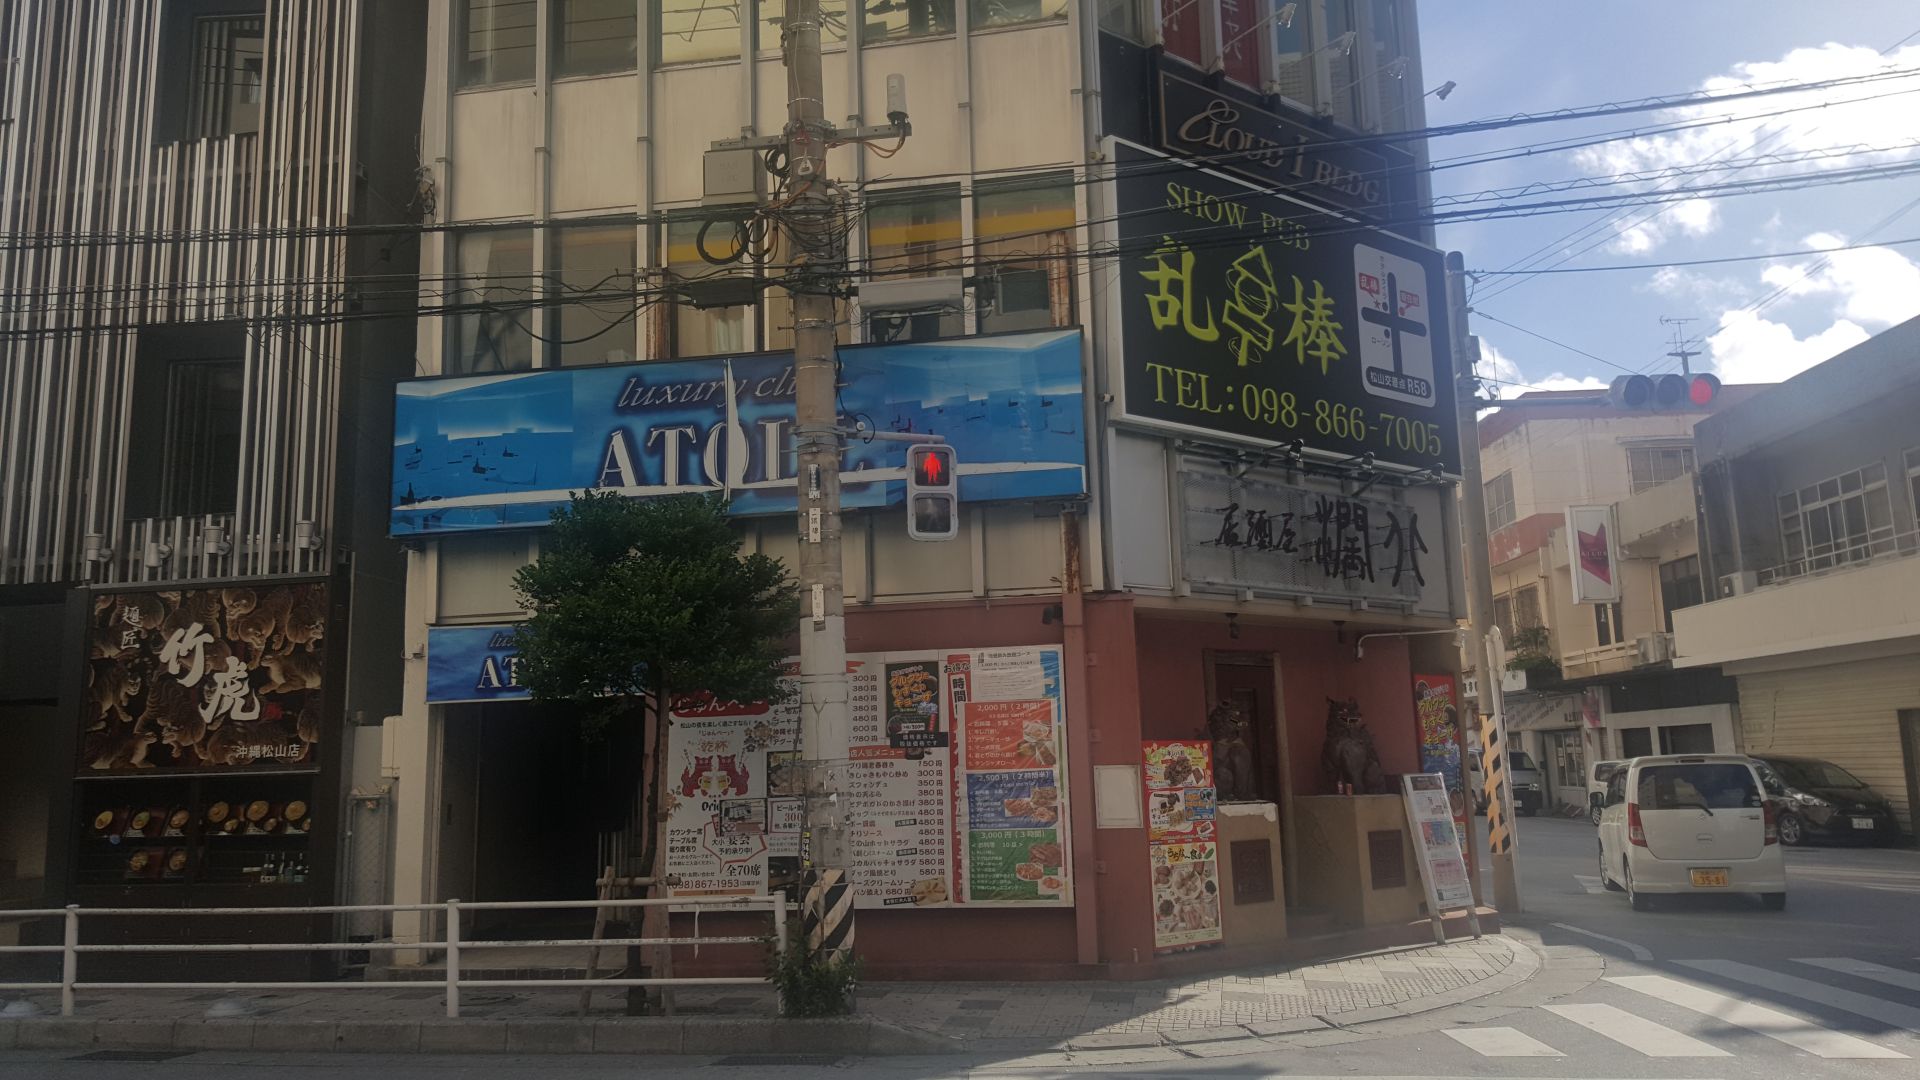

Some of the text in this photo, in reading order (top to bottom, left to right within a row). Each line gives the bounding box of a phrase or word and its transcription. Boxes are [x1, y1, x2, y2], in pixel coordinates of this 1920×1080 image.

[1166, 181, 1248, 230] SHOW
[1281, 273, 1349, 376] 棒
[1407, 378, 1428, 397] R58
[598, 414, 846, 488] ATOL
[159, 621, 261, 724] 竹虎
[944, 662, 971, 674] お得な
[235, 743, 301, 759] 沖縄松山店
[918, 789, 944, 797] 380円
[669, 837, 697, 845] テーブル席
[980, 831, 1012, 840] 3,000円
[918, 848, 945, 856] 580円
[918, 858, 945, 866] 580円
[726, 864, 761, 877] 全70席
[919, 868, 945, 876] 580円
